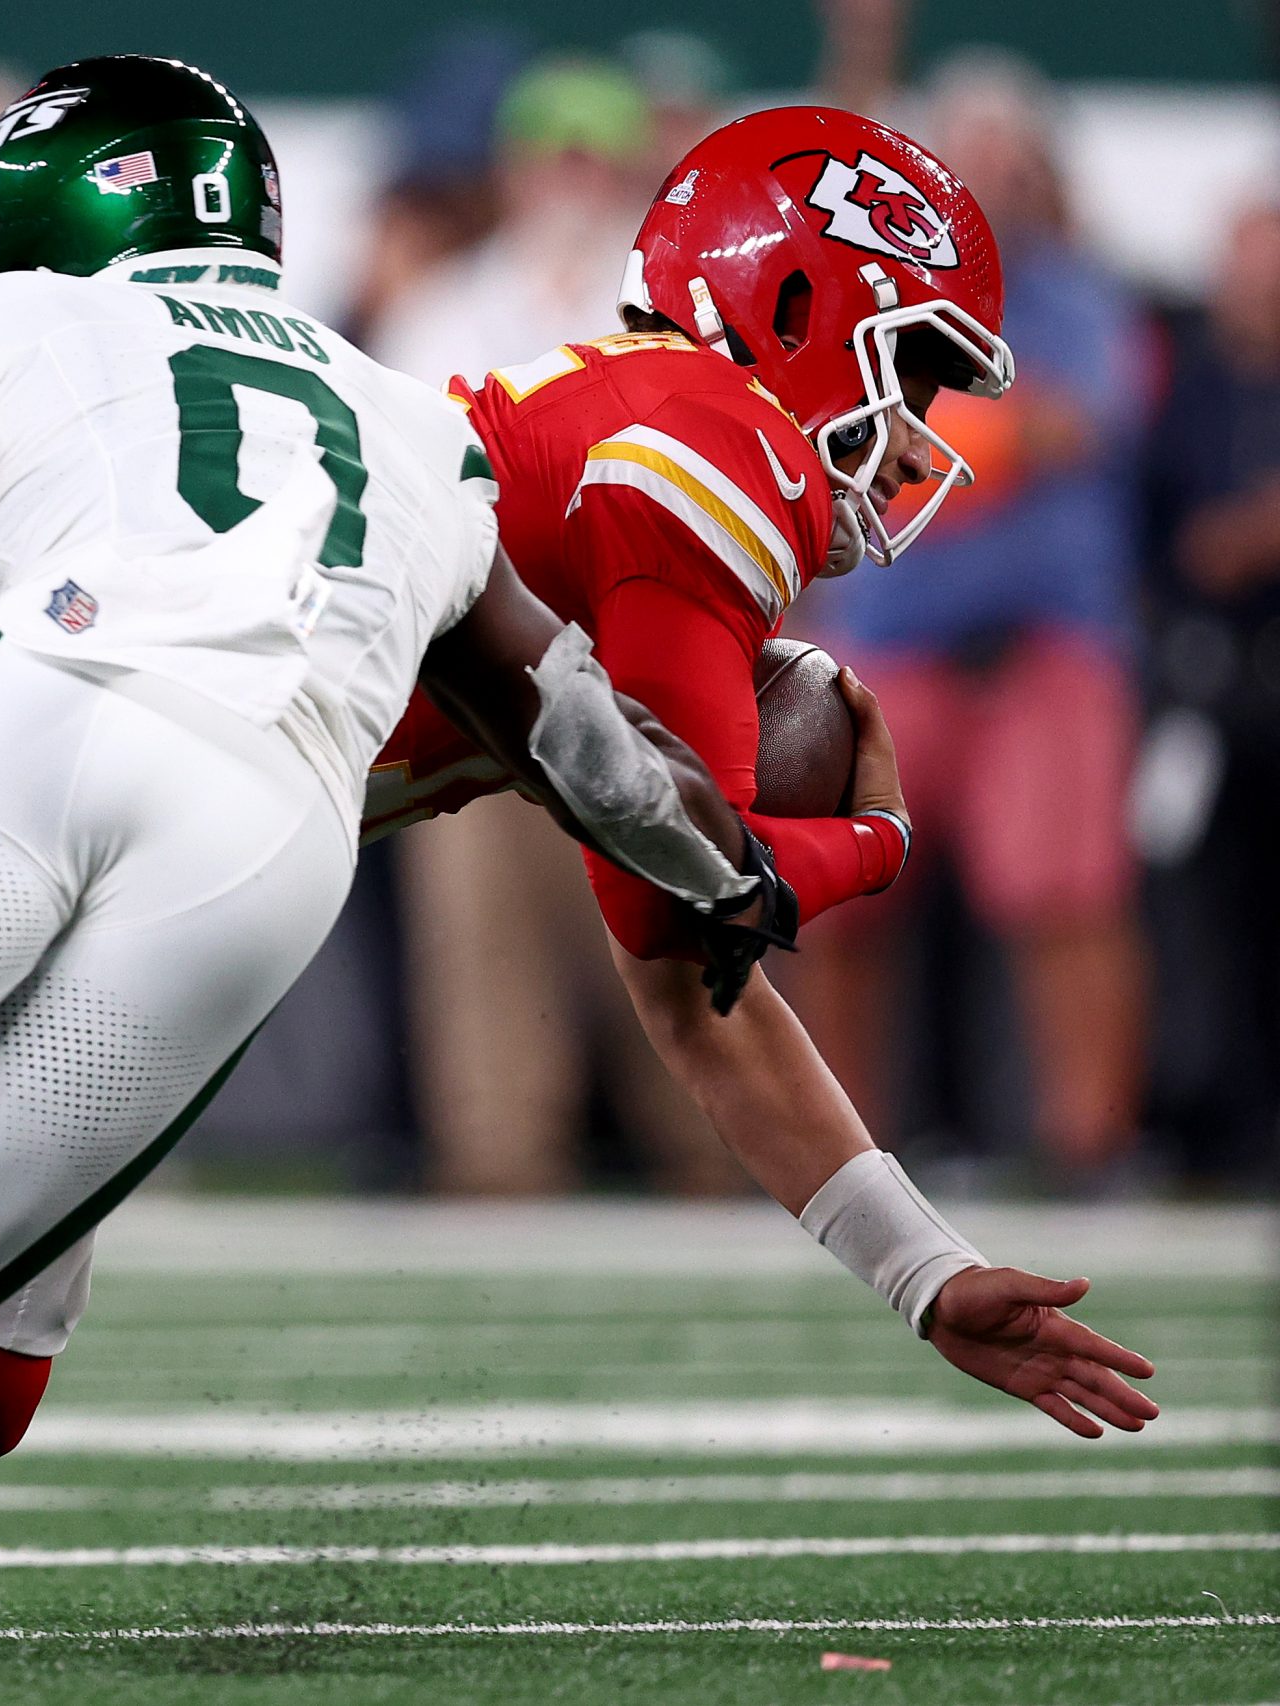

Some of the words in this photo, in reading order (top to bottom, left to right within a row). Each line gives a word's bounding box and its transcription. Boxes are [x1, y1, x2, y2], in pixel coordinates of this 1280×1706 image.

[191, 173, 233, 223] 0
[843, 170, 939, 260] KC
[127, 264, 212, 283] NEW
[216, 264, 281, 290] YORK
[691, 285, 710, 303] 15
[153, 293, 331, 364] AMOS
[168, 344, 369, 568] 0
